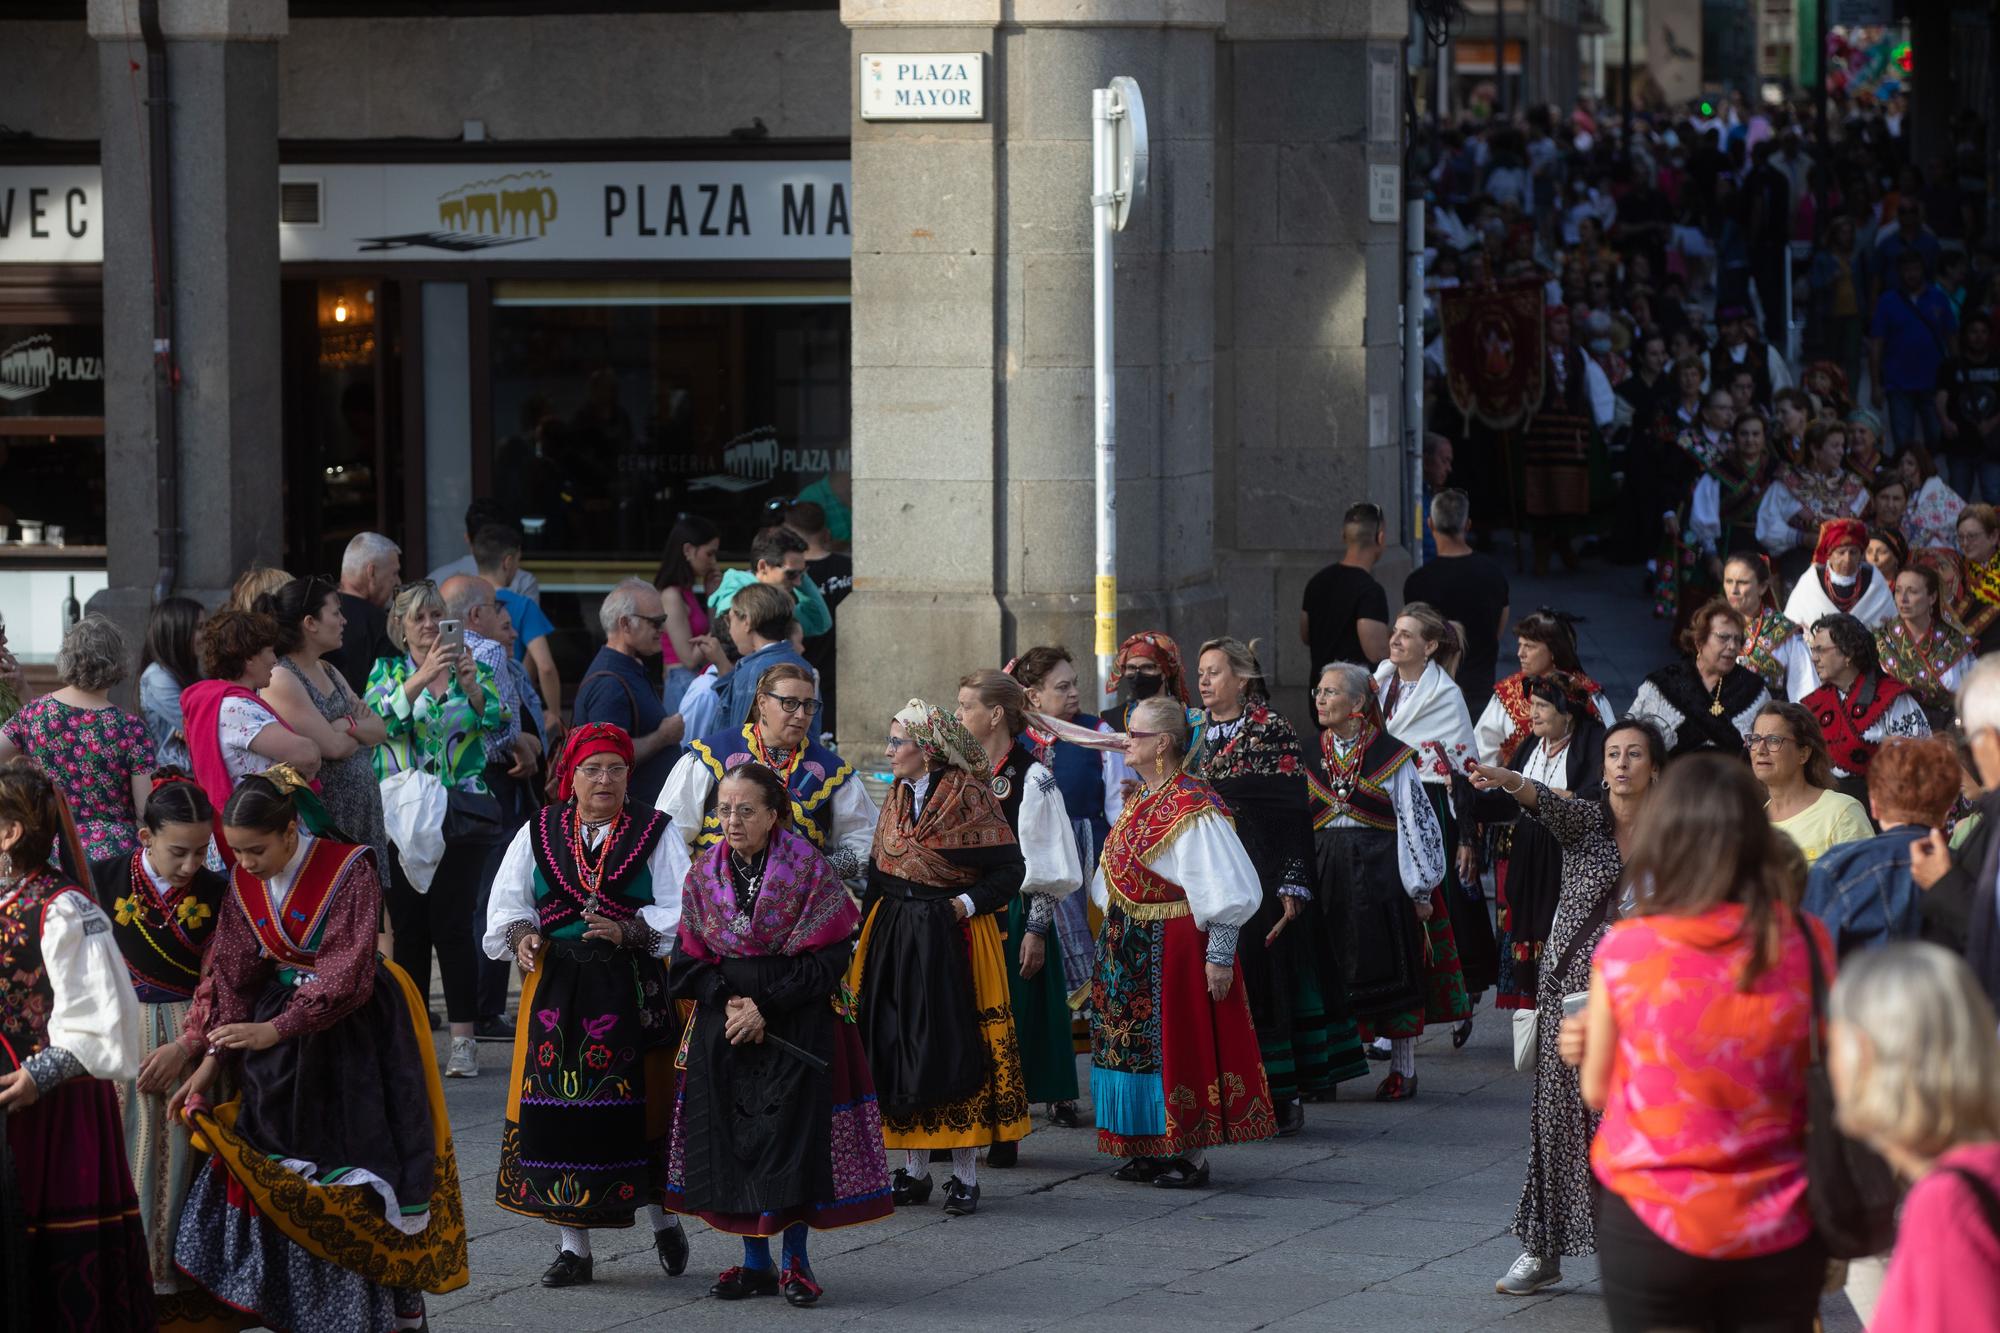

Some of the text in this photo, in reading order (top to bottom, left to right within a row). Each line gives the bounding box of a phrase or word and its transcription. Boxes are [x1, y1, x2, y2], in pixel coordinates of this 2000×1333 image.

[897, 63, 968, 80] PLAZA
[895, 88, 971, 106] MAYOR
[604, 183, 850, 237] PLAZA MA
[57, 355, 104, 380] PLAZA
[782, 449, 831, 471] PLAZA
